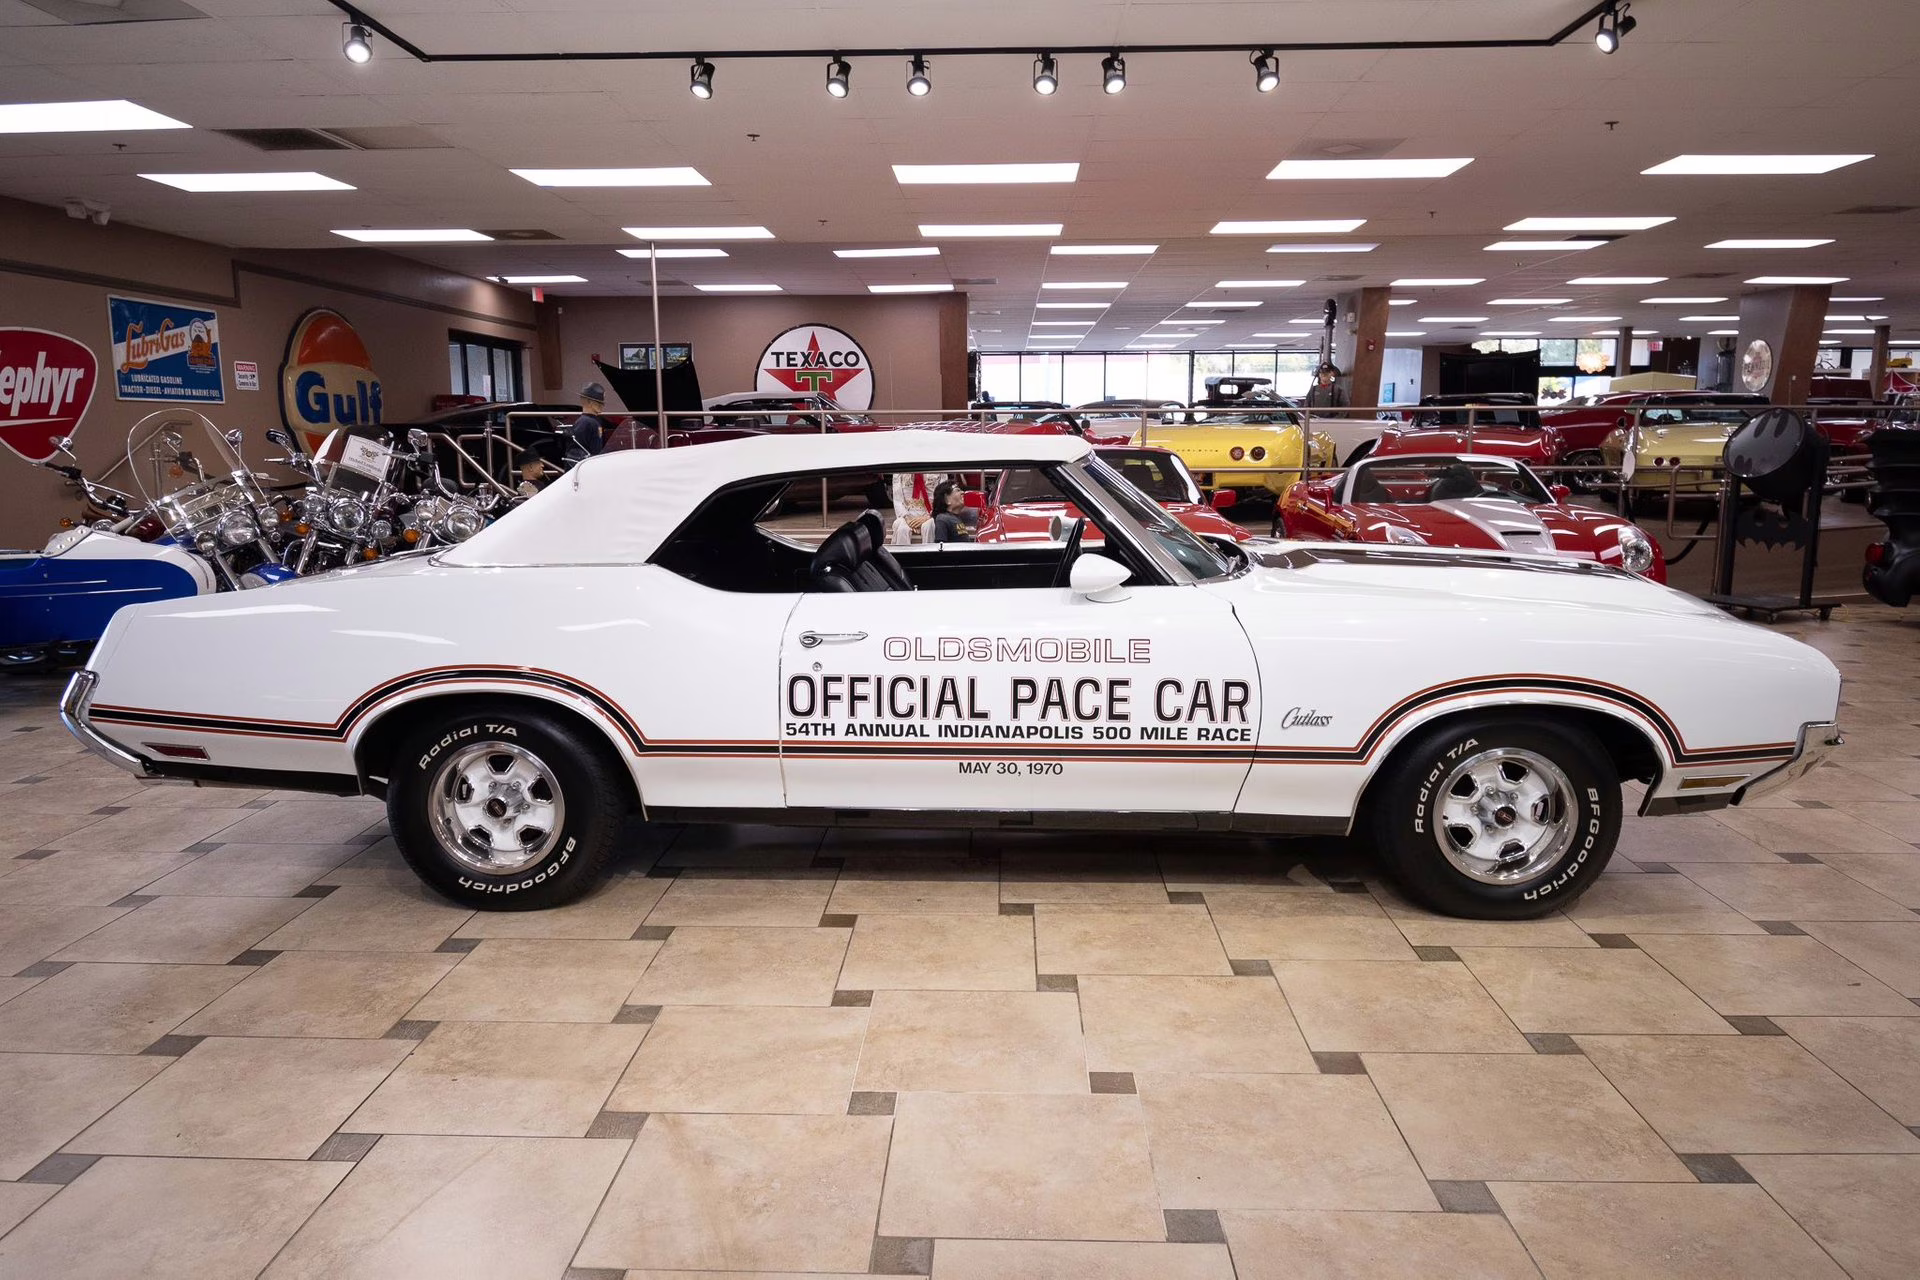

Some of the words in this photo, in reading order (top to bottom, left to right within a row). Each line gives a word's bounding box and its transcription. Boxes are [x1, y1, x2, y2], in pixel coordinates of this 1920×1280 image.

[770, 350, 861, 368] TEXACO
[0, 350, 85, 417] ephyr
[131, 374, 160, 383] LUBRICATED
[160, 376, 183, 385] GASOLINE
[192, 389, 209, 397] MARINE
[295, 371, 383, 426] Gulf
[883, 636, 1151, 664] OLDSMOBILE
[786, 673, 991, 721] OFFICIAL
[1010, 676, 1132, 723] PACE
[1154, 677, 1251, 725] CAR
[1280, 706, 1333, 730] Cutlass
[418, 725, 478, 771] Radial
[485, 723, 518, 737] T/A
[785, 722, 836, 737] 54TH
[844, 723, 930, 738] ANNUAL
[938, 724, 1084, 740] INDIANAPOLIS
[1092, 726, 1132, 741] 500
[1139, 726, 1188, 741] MILE
[1197, 727, 1252, 742] RACE
[958, 762, 992, 775] MAY
[996, 762, 1022, 777] 30,
[1026, 763, 1064, 776] 1970
[1414, 761, 1445, 833] Radial
[1446, 737, 1480, 761] T/A
[1523, 788, 1601, 902] BFGoodrich
[458, 836, 577, 894] BFGoodrich
